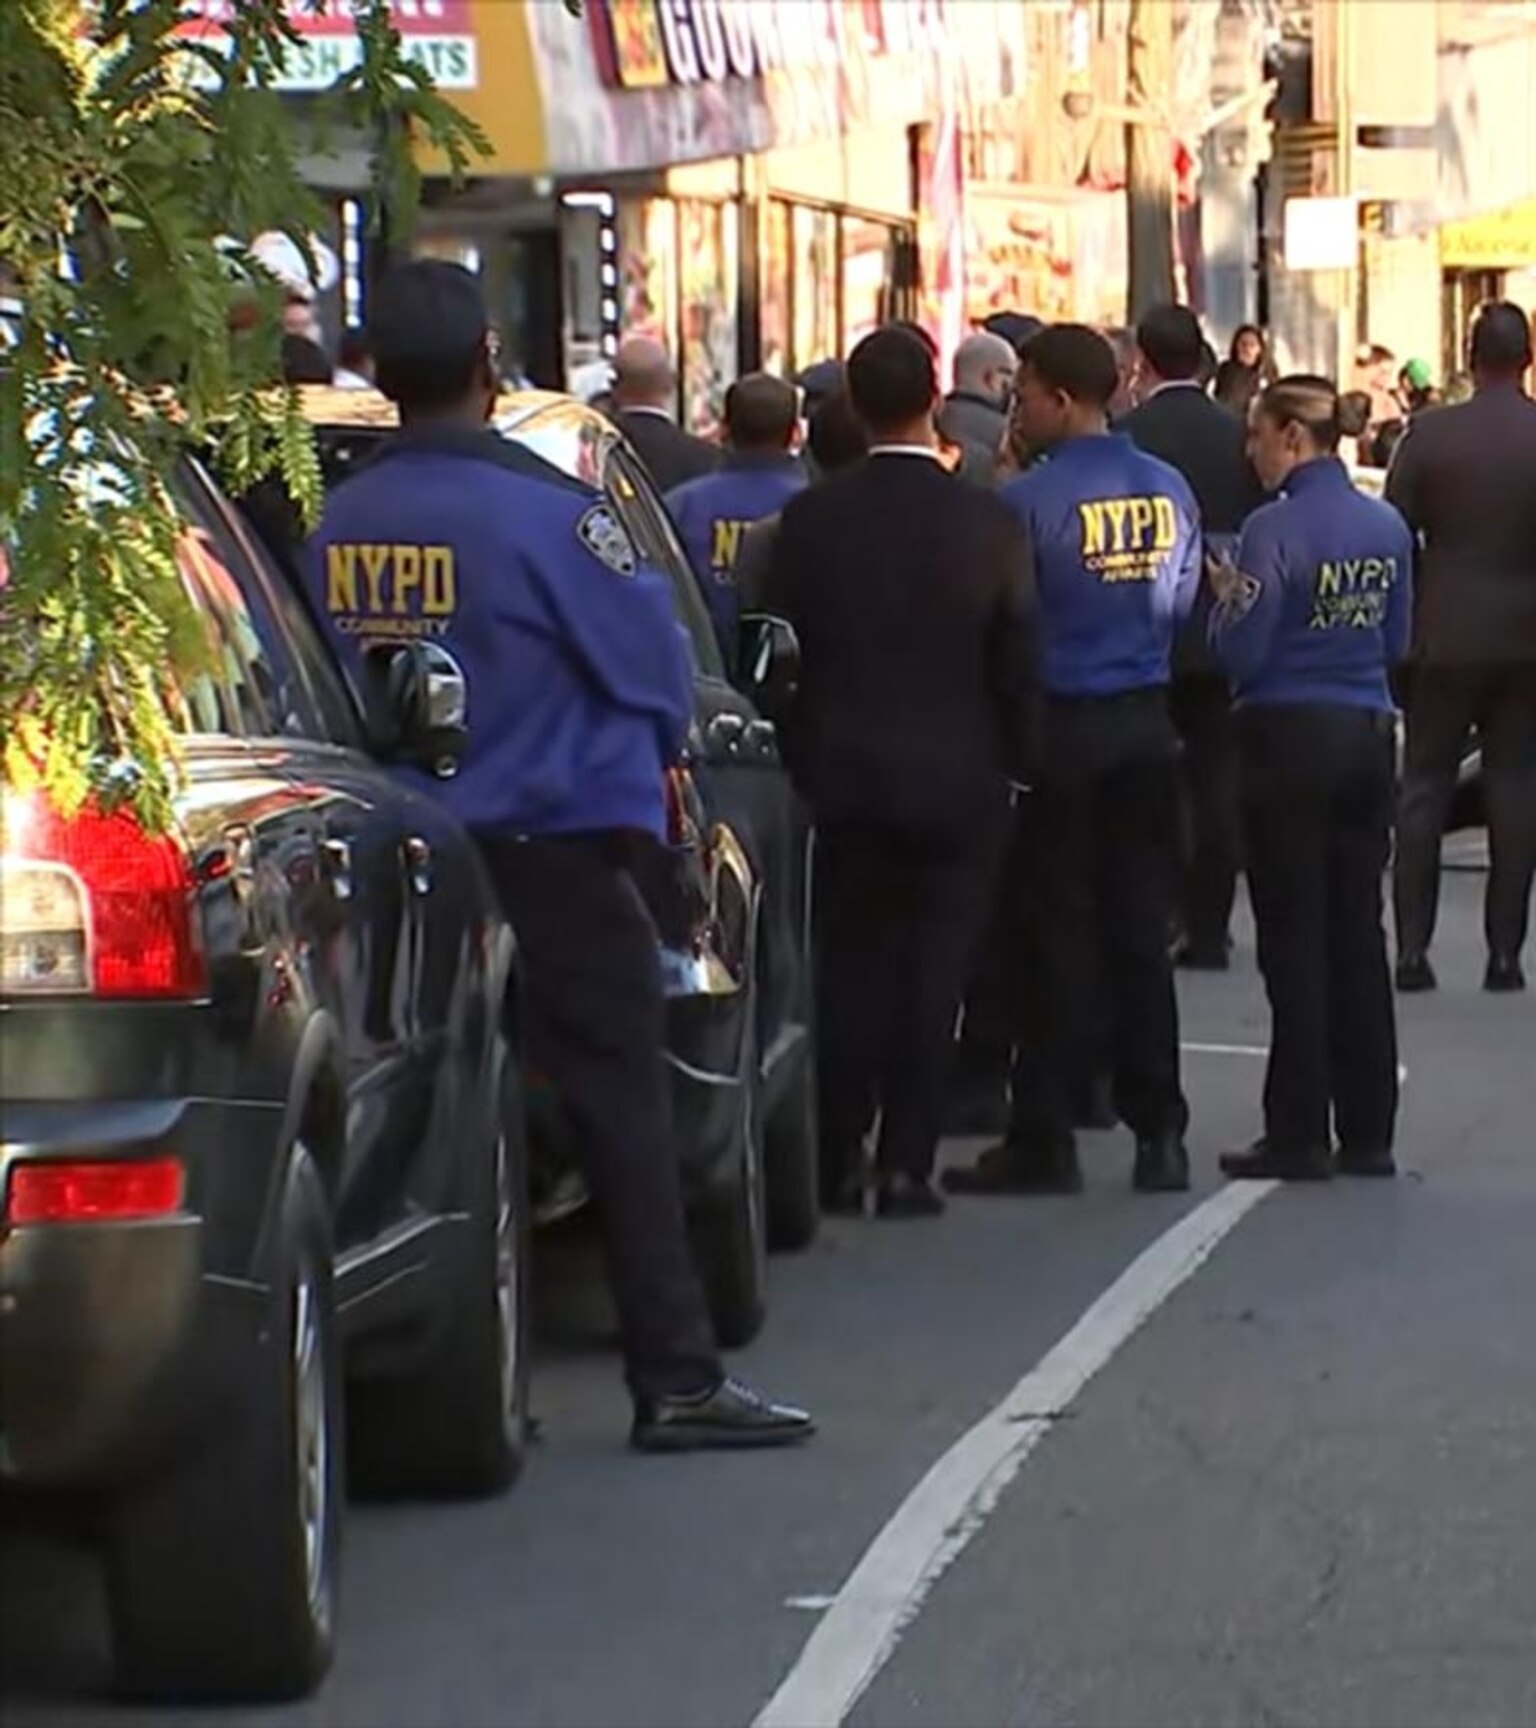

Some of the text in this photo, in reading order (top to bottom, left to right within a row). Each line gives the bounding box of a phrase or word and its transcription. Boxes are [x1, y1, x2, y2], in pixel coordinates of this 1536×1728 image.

[1079, 496, 1177, 555] NYPD
[327, 544, 456, 615] NYPD
[1318, 557, 1398, 596] NYPD
